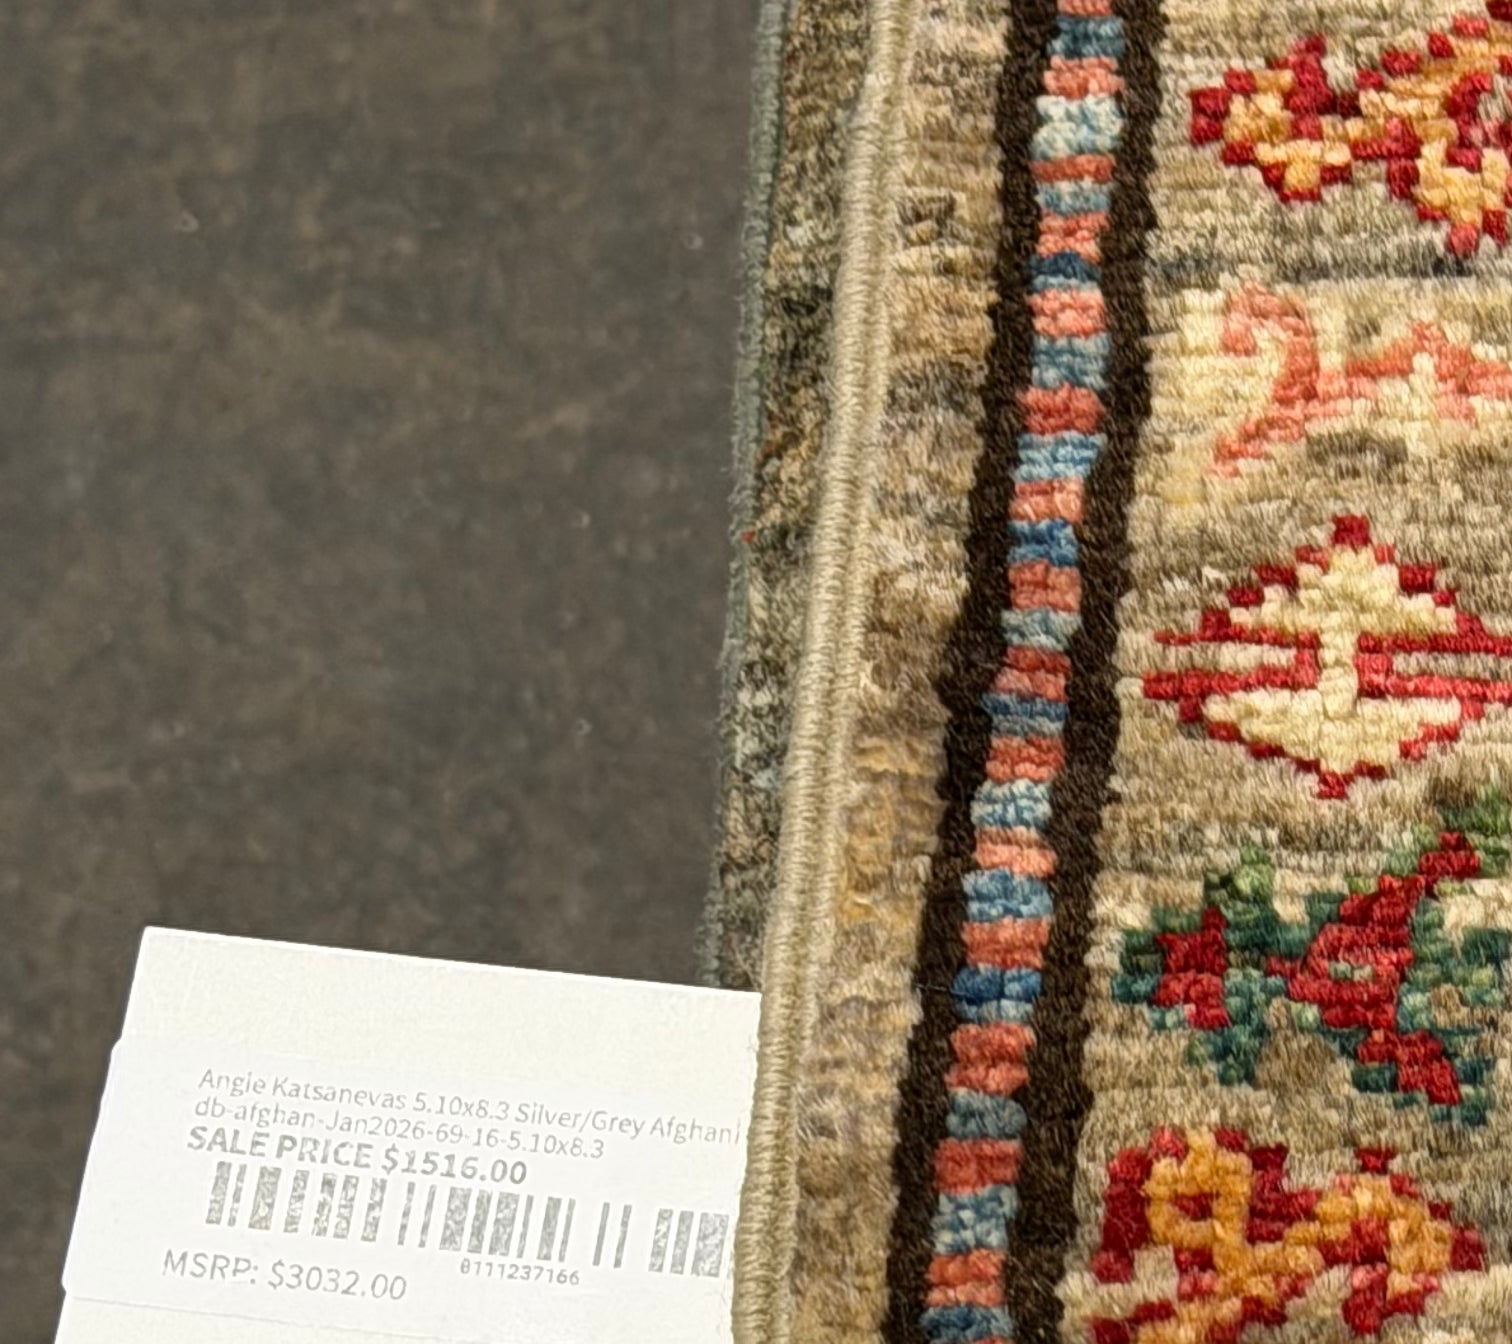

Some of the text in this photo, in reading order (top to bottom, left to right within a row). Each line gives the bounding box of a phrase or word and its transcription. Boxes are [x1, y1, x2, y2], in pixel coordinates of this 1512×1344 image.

[198, 1068, 267, 1097] Angie
[272, 1076, 407, 1111] Katsanevas
[412, 1091, 510, 1121] 5.10x8.3
[514, 1102, 646, 1140] Silver/Grey
[188, 1125, 528, 1185] SALE PRICE $1516.00
[162, 1248, 408, 1301] MSRP: $3032.00
